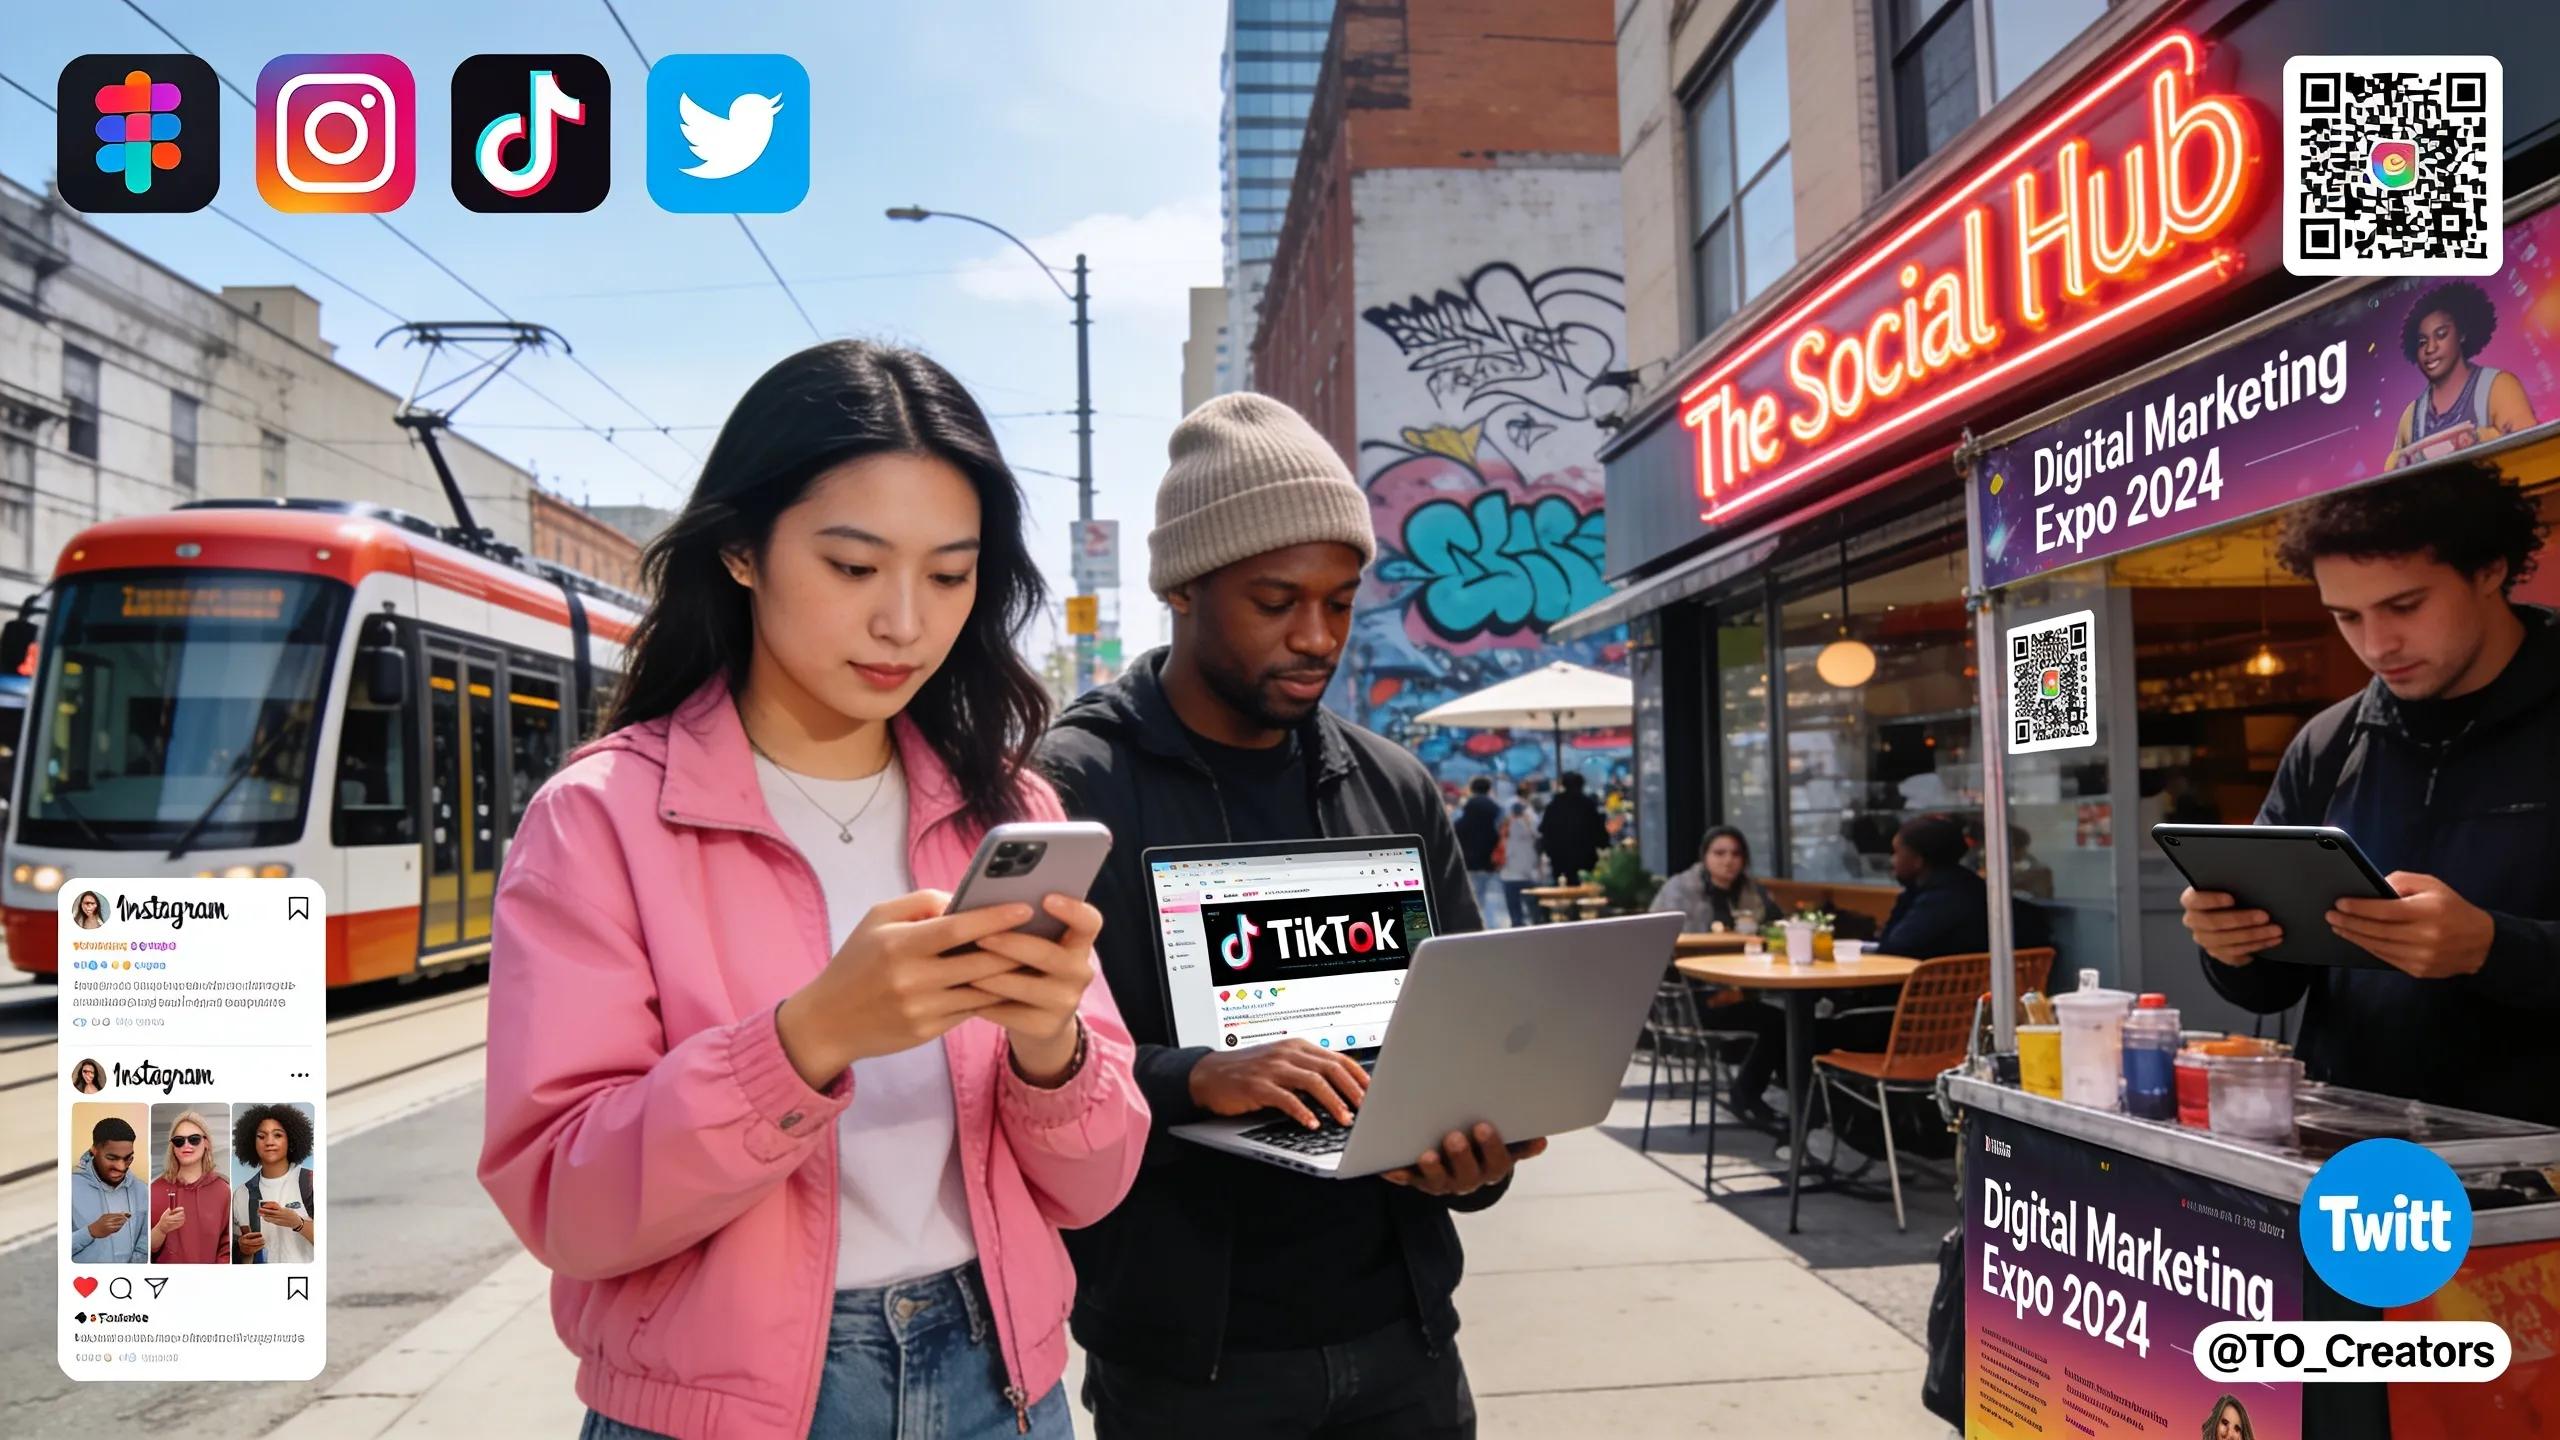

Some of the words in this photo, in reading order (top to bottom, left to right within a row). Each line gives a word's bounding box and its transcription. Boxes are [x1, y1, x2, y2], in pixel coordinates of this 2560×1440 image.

[1685, 383, 1778, 498] The
[1788, 209, 1996, 442] Social
[2013, 69, 2246, 323] Hub
[2034, 410, 2134, 497] Digital
[2145, 340, 2348, 456] Marketing
[2035, 495, 2118, 554] Expo
[2126, 446, 2224, 527] 2024
[1267, 911, 1399, 960] TikTok
[1982, 1241, 2054, 1320] Expo
[2062, 1273, 2150, 1360] 2024
[1983, 1176, 2077, 1257] Digital
[2086, 1204, 2274, 1321] Marketing
